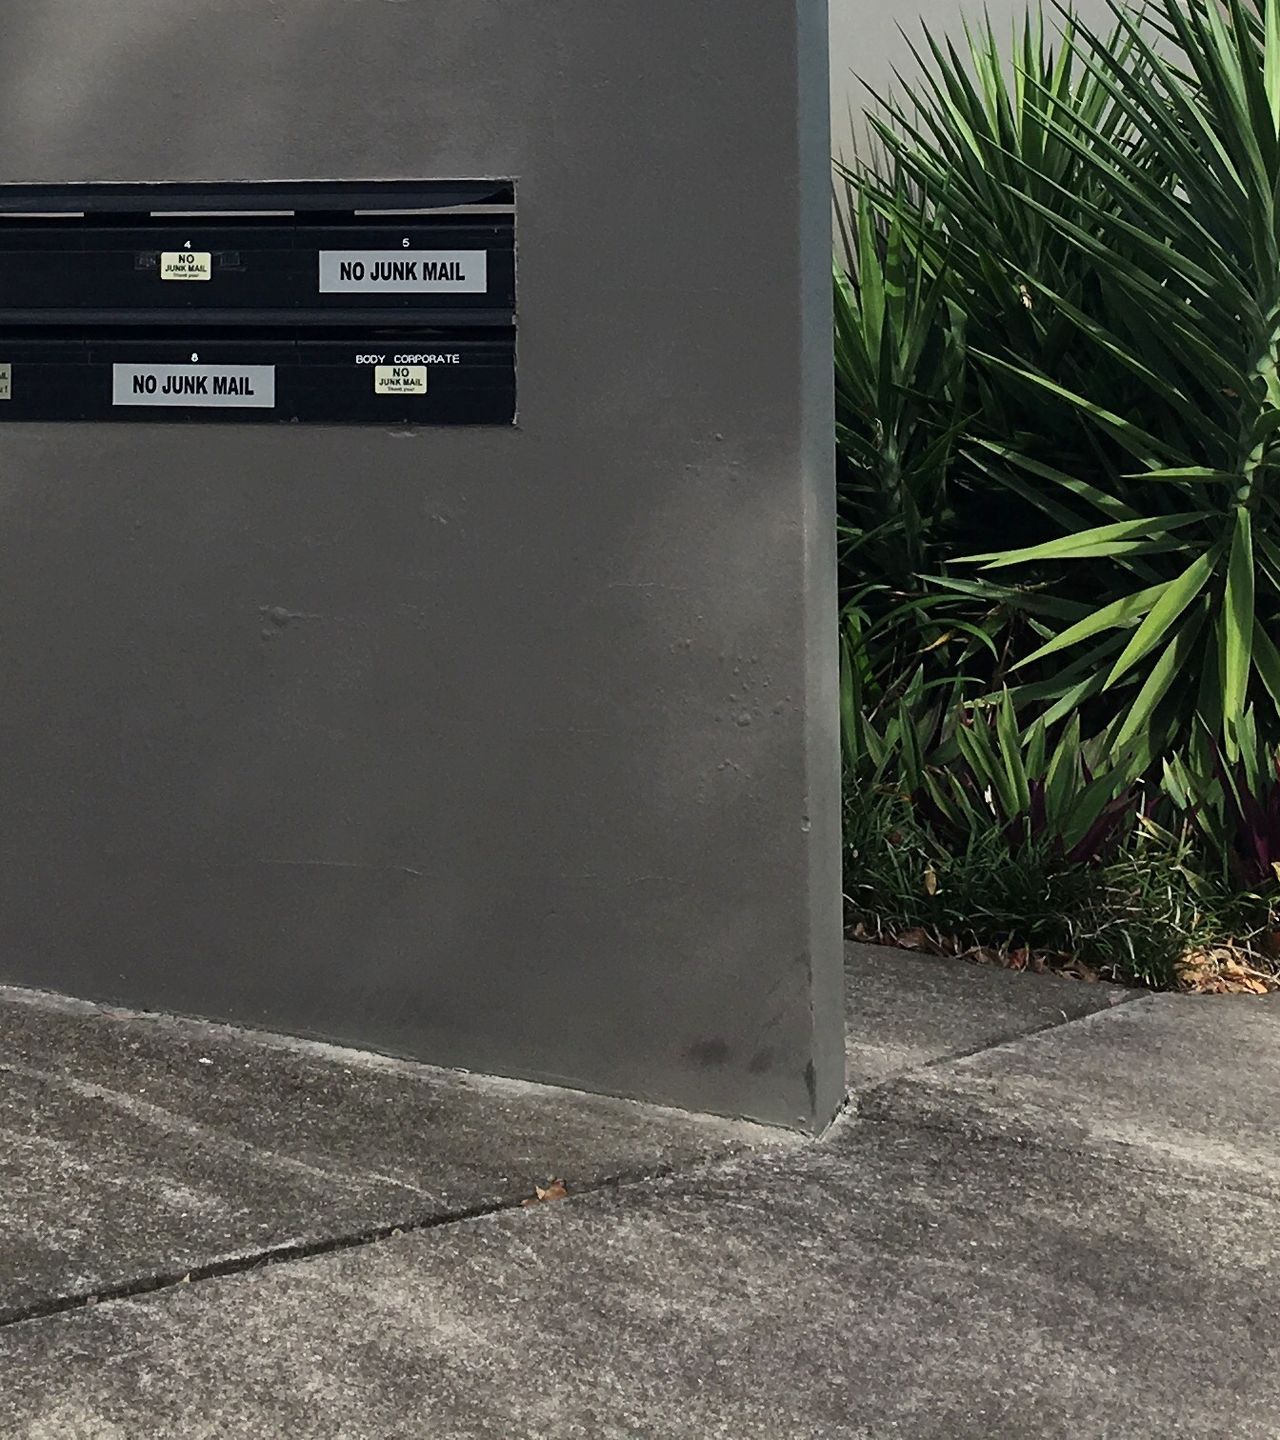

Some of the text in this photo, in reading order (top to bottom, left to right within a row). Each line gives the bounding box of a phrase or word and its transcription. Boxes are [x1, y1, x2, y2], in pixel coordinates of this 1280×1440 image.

[183, 240, 192, 249] 4
[402, 238, 410, 247] 5
[178, 254, 195, 264] NO
[340, 262, 466, 281] NO JUNK MAIL
[191, 353, 199, 362] 8
[355, 354, 460, 364] BODY CORPORATE
[392, 368, 410, 377] NO
[133, 375, 255, 396] NO JUNK MAIL
[379, 378, 423, 386] JUNK MAIL
